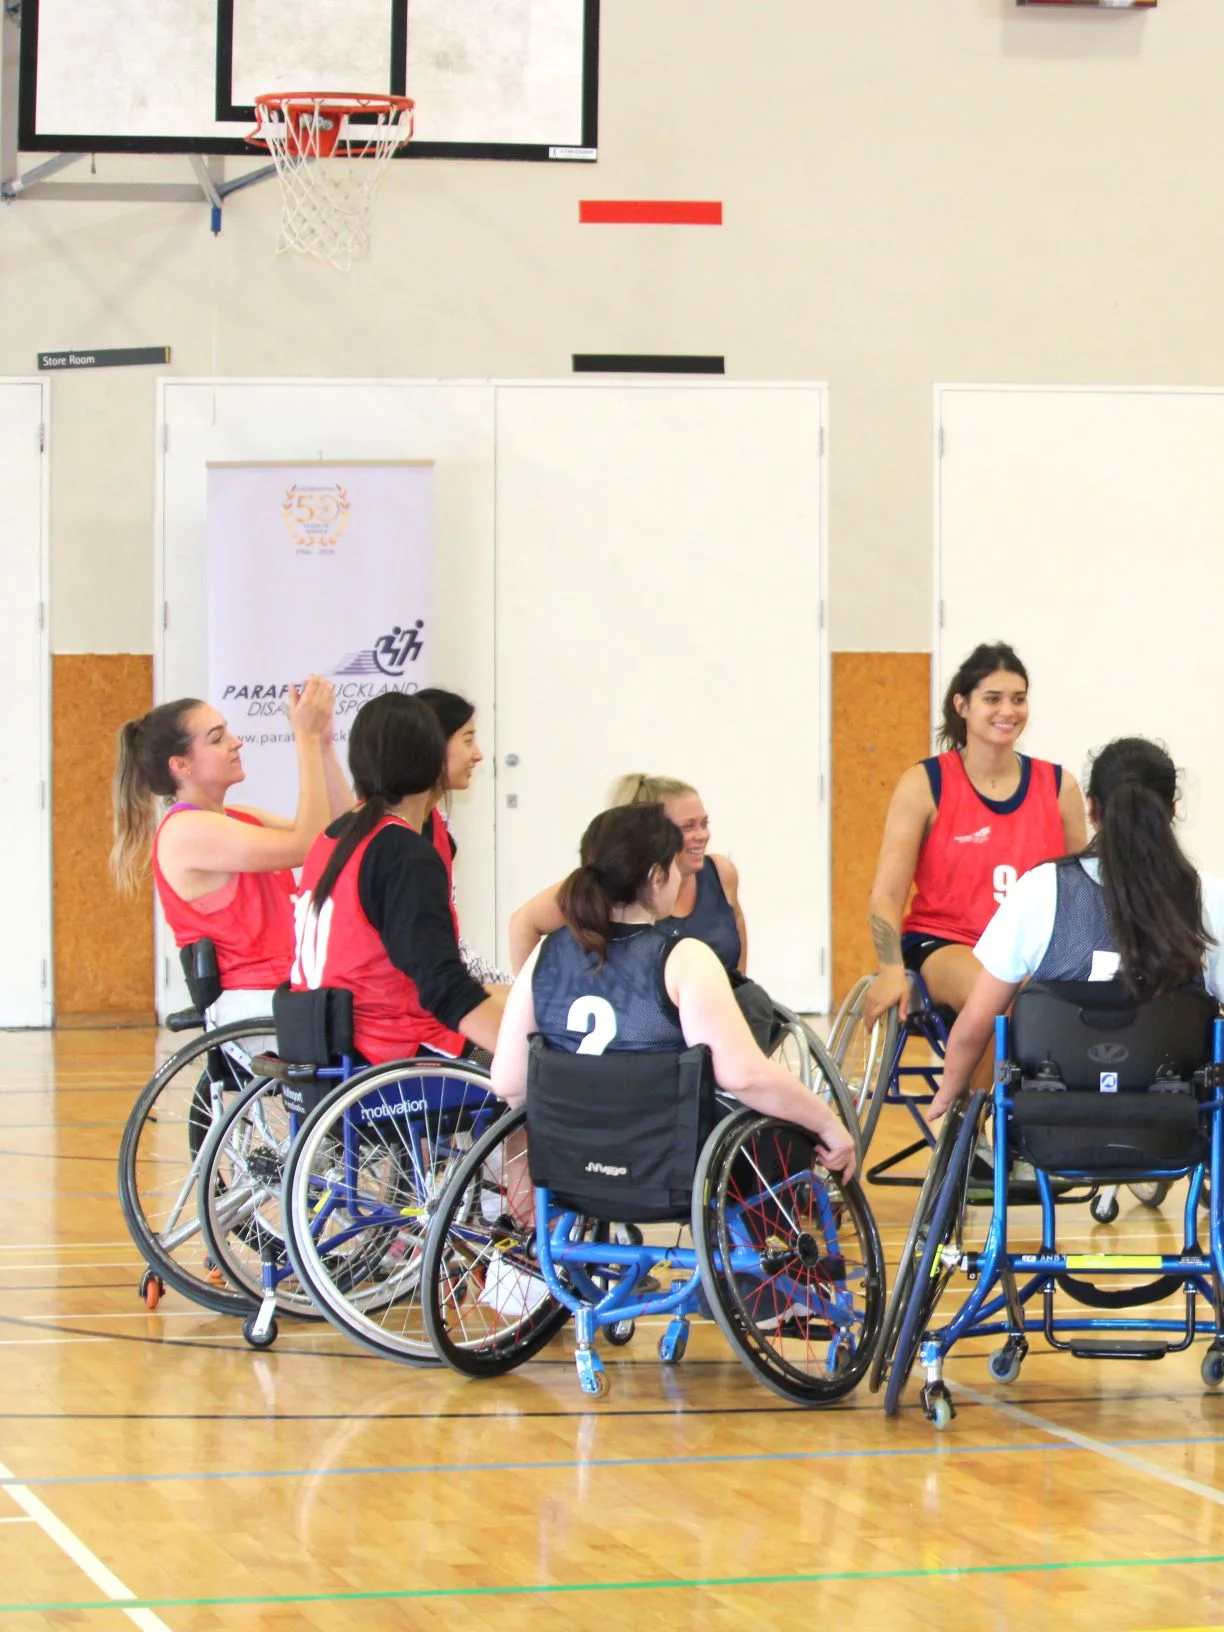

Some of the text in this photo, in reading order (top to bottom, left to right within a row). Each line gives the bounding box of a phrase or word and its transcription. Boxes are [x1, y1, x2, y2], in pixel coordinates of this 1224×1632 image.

[42, 354, 95, 366] Store Room
[566, 994, 617, 1056] 2
[360, 1098, 428, 1120] motivation
